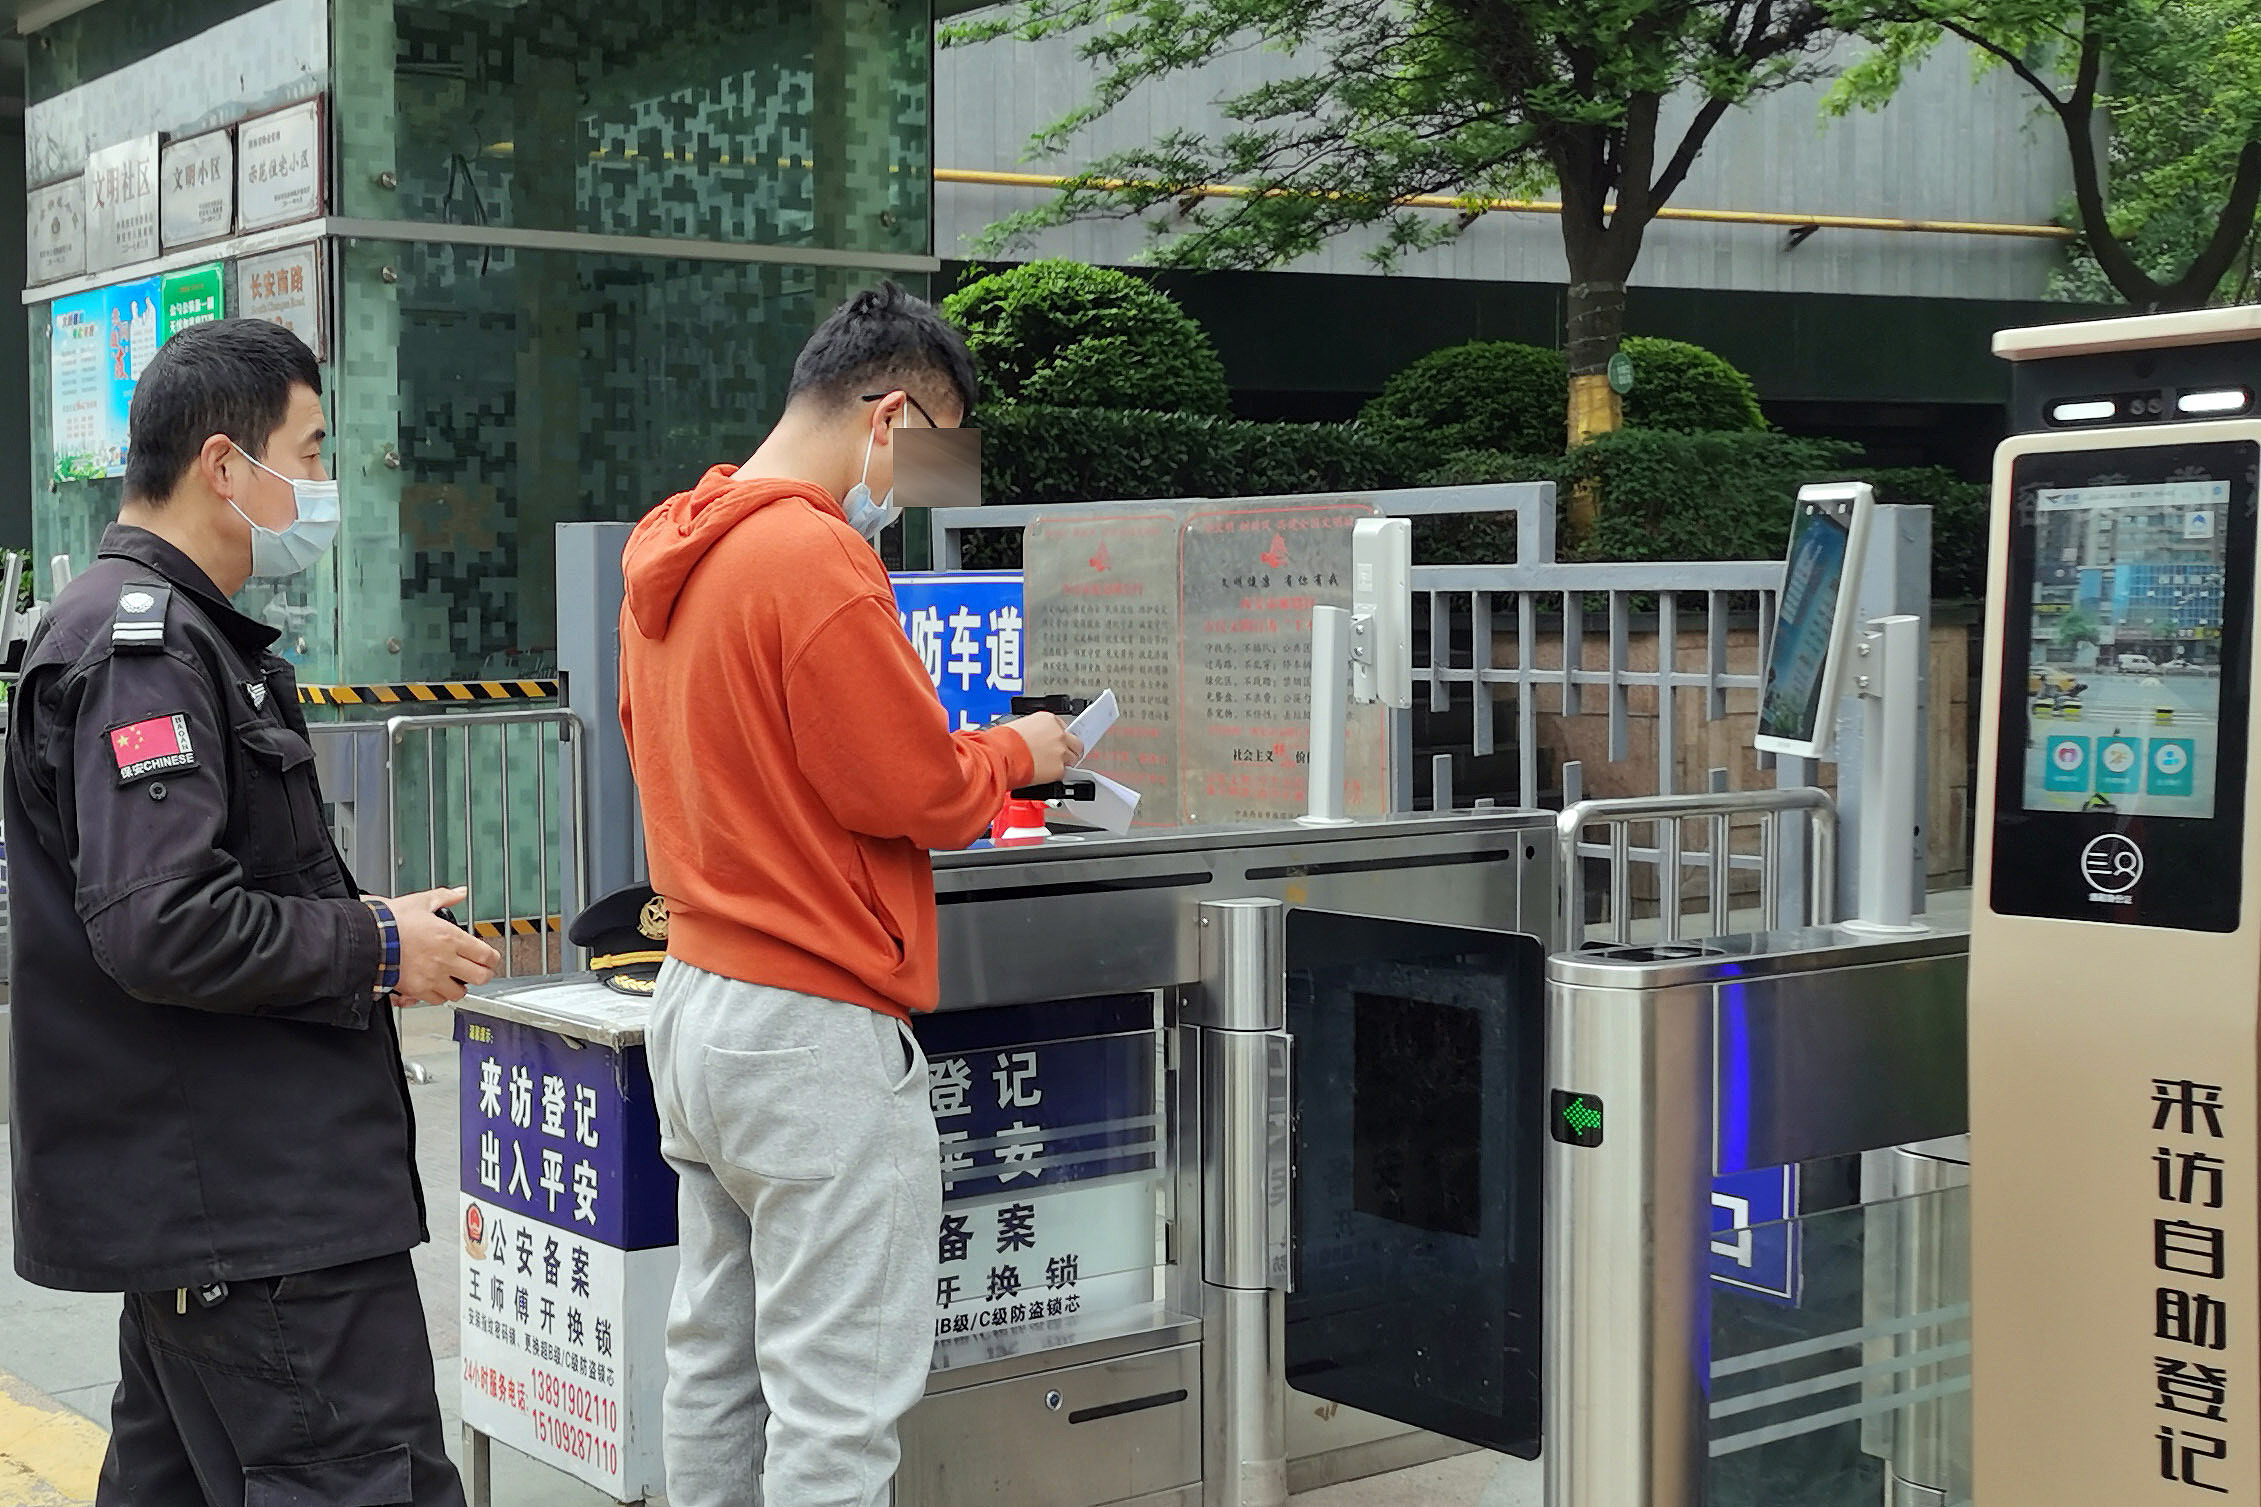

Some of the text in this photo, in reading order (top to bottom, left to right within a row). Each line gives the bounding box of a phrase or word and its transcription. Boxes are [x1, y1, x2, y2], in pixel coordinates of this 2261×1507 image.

[92, 156, 151, 211] 文明社区
[172, 156, 221, 192] 文明小区
[250, 264, 304, 300] 长安南路
[1284, 572, 1339, 587] 有你有我
[899, 605, 1023, 692] 防车道
[478, 1056, 600, 1149] 来访登记
[928, 1051, 1043, 1117] 登记
[479, 1130, 599, 1226] 出入平安
[490, 1218, 590, 1299] 公安备案
[938, 1203, 1037, 1264] 备案
[469, 1267, 612, 1359] 王师傅开换锁
[934, 1294, 1081, 1338] B级/C级防盗锁芯
[2150, 1078, 2229, 1494] 来访自助登记
[531, 1368, 617, 1433] 13891902110
[532, 1409, 617, 1476] 15109287110
